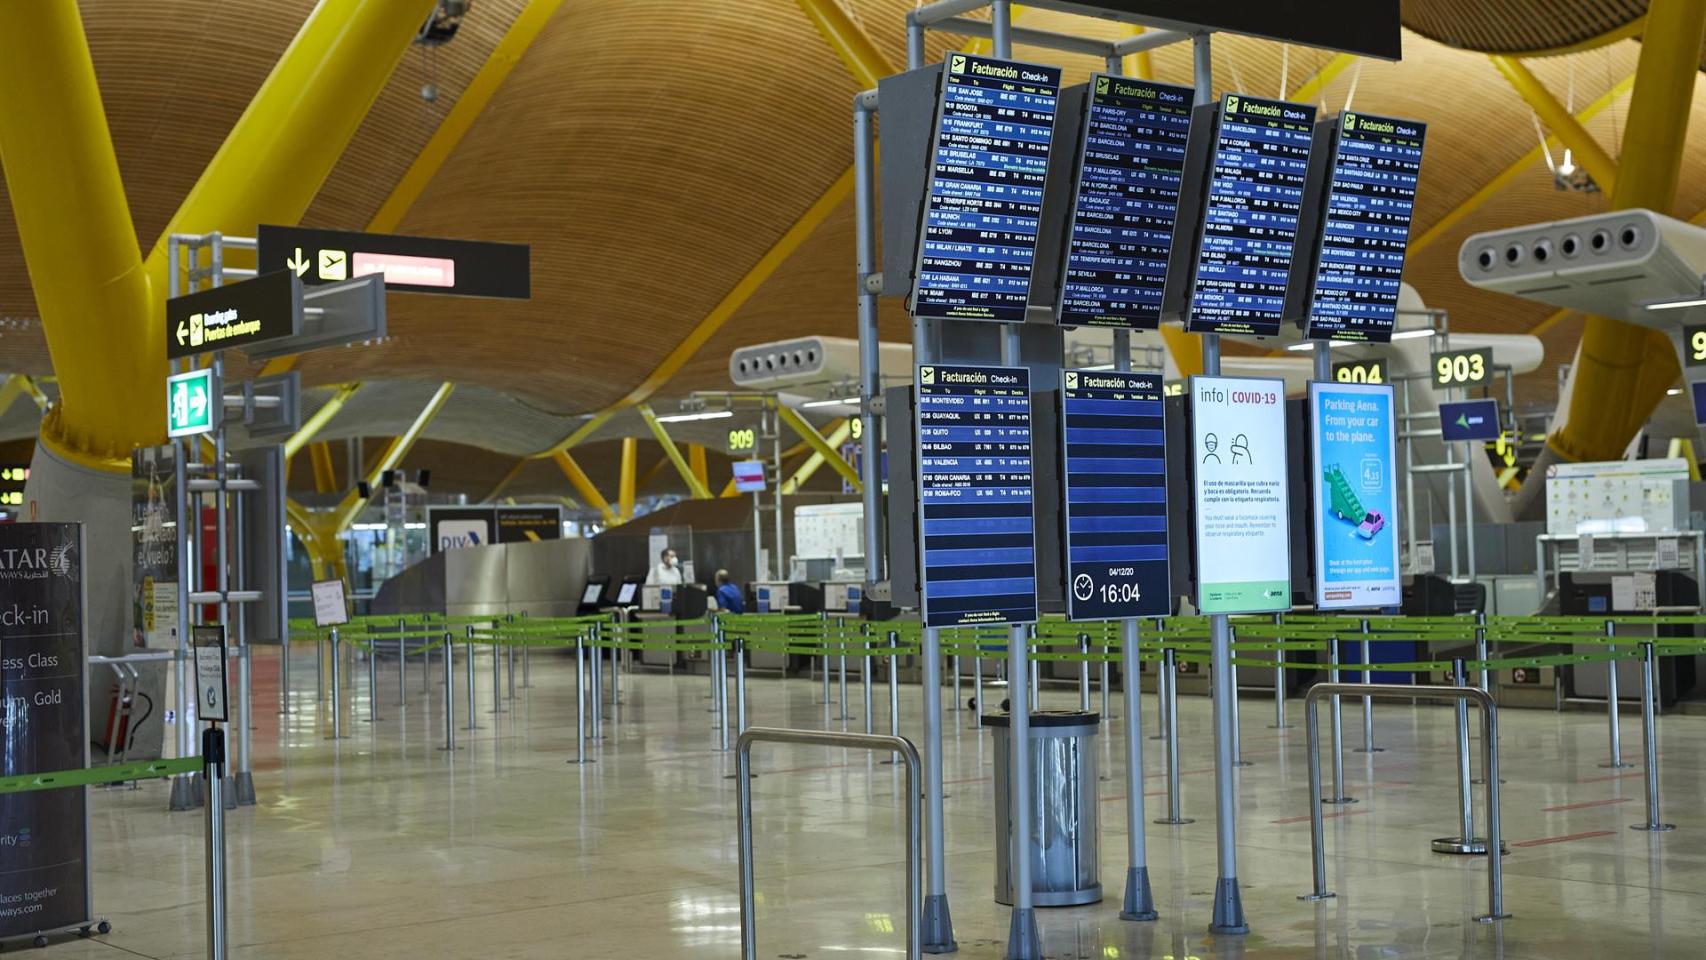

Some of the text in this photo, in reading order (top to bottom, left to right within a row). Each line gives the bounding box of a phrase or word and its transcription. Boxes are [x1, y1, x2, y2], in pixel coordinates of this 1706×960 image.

[972, 61, 1048, 82] Facturación Check-in
[1115, 82, 1183, 102] Facturación Check-in
[1243, 101, 1306, 119] Facturación Check-in
[954, 119, 983, 128] FRANKFURT
[1100, 122, 1127, 131] BARCELONA
[1231, 125, 1256, 133] BARCELONA
[1360, 119, 1416, 135] Facturación Check-in
[1098, 138, 1124, 146] BARCELONA
[950, 150, 976, 158] BRUSELAS
[948, 166, 974, 174] MARSELLA
[942, 371, 986, 382] Facturación
[1337, 364, 1382, 384] 904
[1437, 354, 1484, 384] 903
[1084, 376, 1152, 389] Facturación Check-in
[1200, 387, 1276, 404] info COVID-19
[1324, 399, 1379, 414] Parking Aena.
[1325, 415, 1379, 428] From your car
[729, 429, 754, 450] 909
[1326, 430, 1376, 444] to the plane.
[1108, 568, 1134, 576] 04/12/20
[1100, 583, 1140, 604] 16:04
[28, 652, 58, 668] Class
[34, 689, 62, 706] Gold
[24, 886, 58, 902] together
